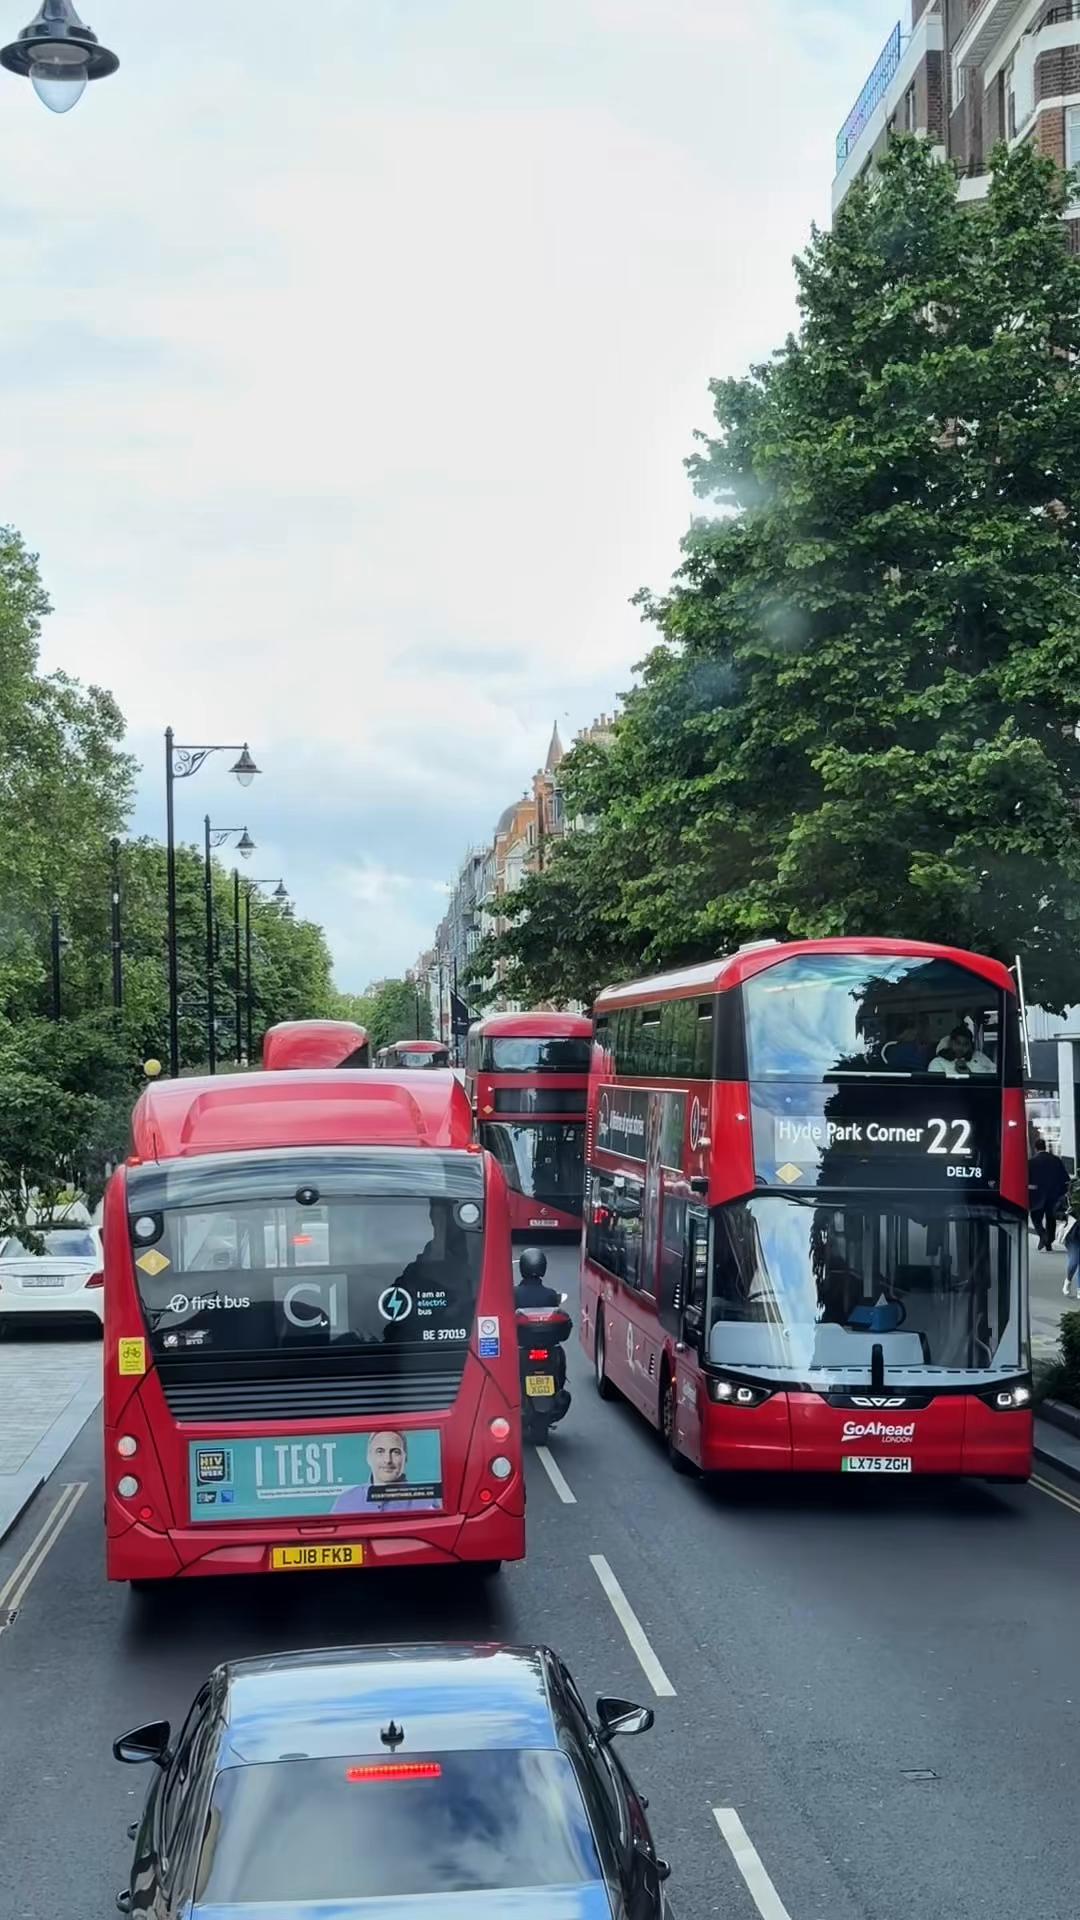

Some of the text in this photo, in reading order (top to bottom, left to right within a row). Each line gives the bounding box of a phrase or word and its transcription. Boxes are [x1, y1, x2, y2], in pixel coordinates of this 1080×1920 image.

[779, 1121, 925, 1143] Hyde Park Corner
[926, 1118, 972, 1154] 22
[946, 1166, 982, 1178] DEL78
[191, 1295, 250, 1310] first bus
[417, 1299, 447, 1307] electric
[418, 1308, 432, 1316] bus
[423, 1328, 466, 1340] BE 37019
[843, 1421, 916, 1436] GoAhead
[200, 1456, 223, 1466] HIV
[255, 1446, 263, 1486] I
[274, 1443, 343, 1486] TEST.
[849, 1458, 909, 1470] LX75 ZGH
[282, 1547, 353, 1565] LJ18 FKB
